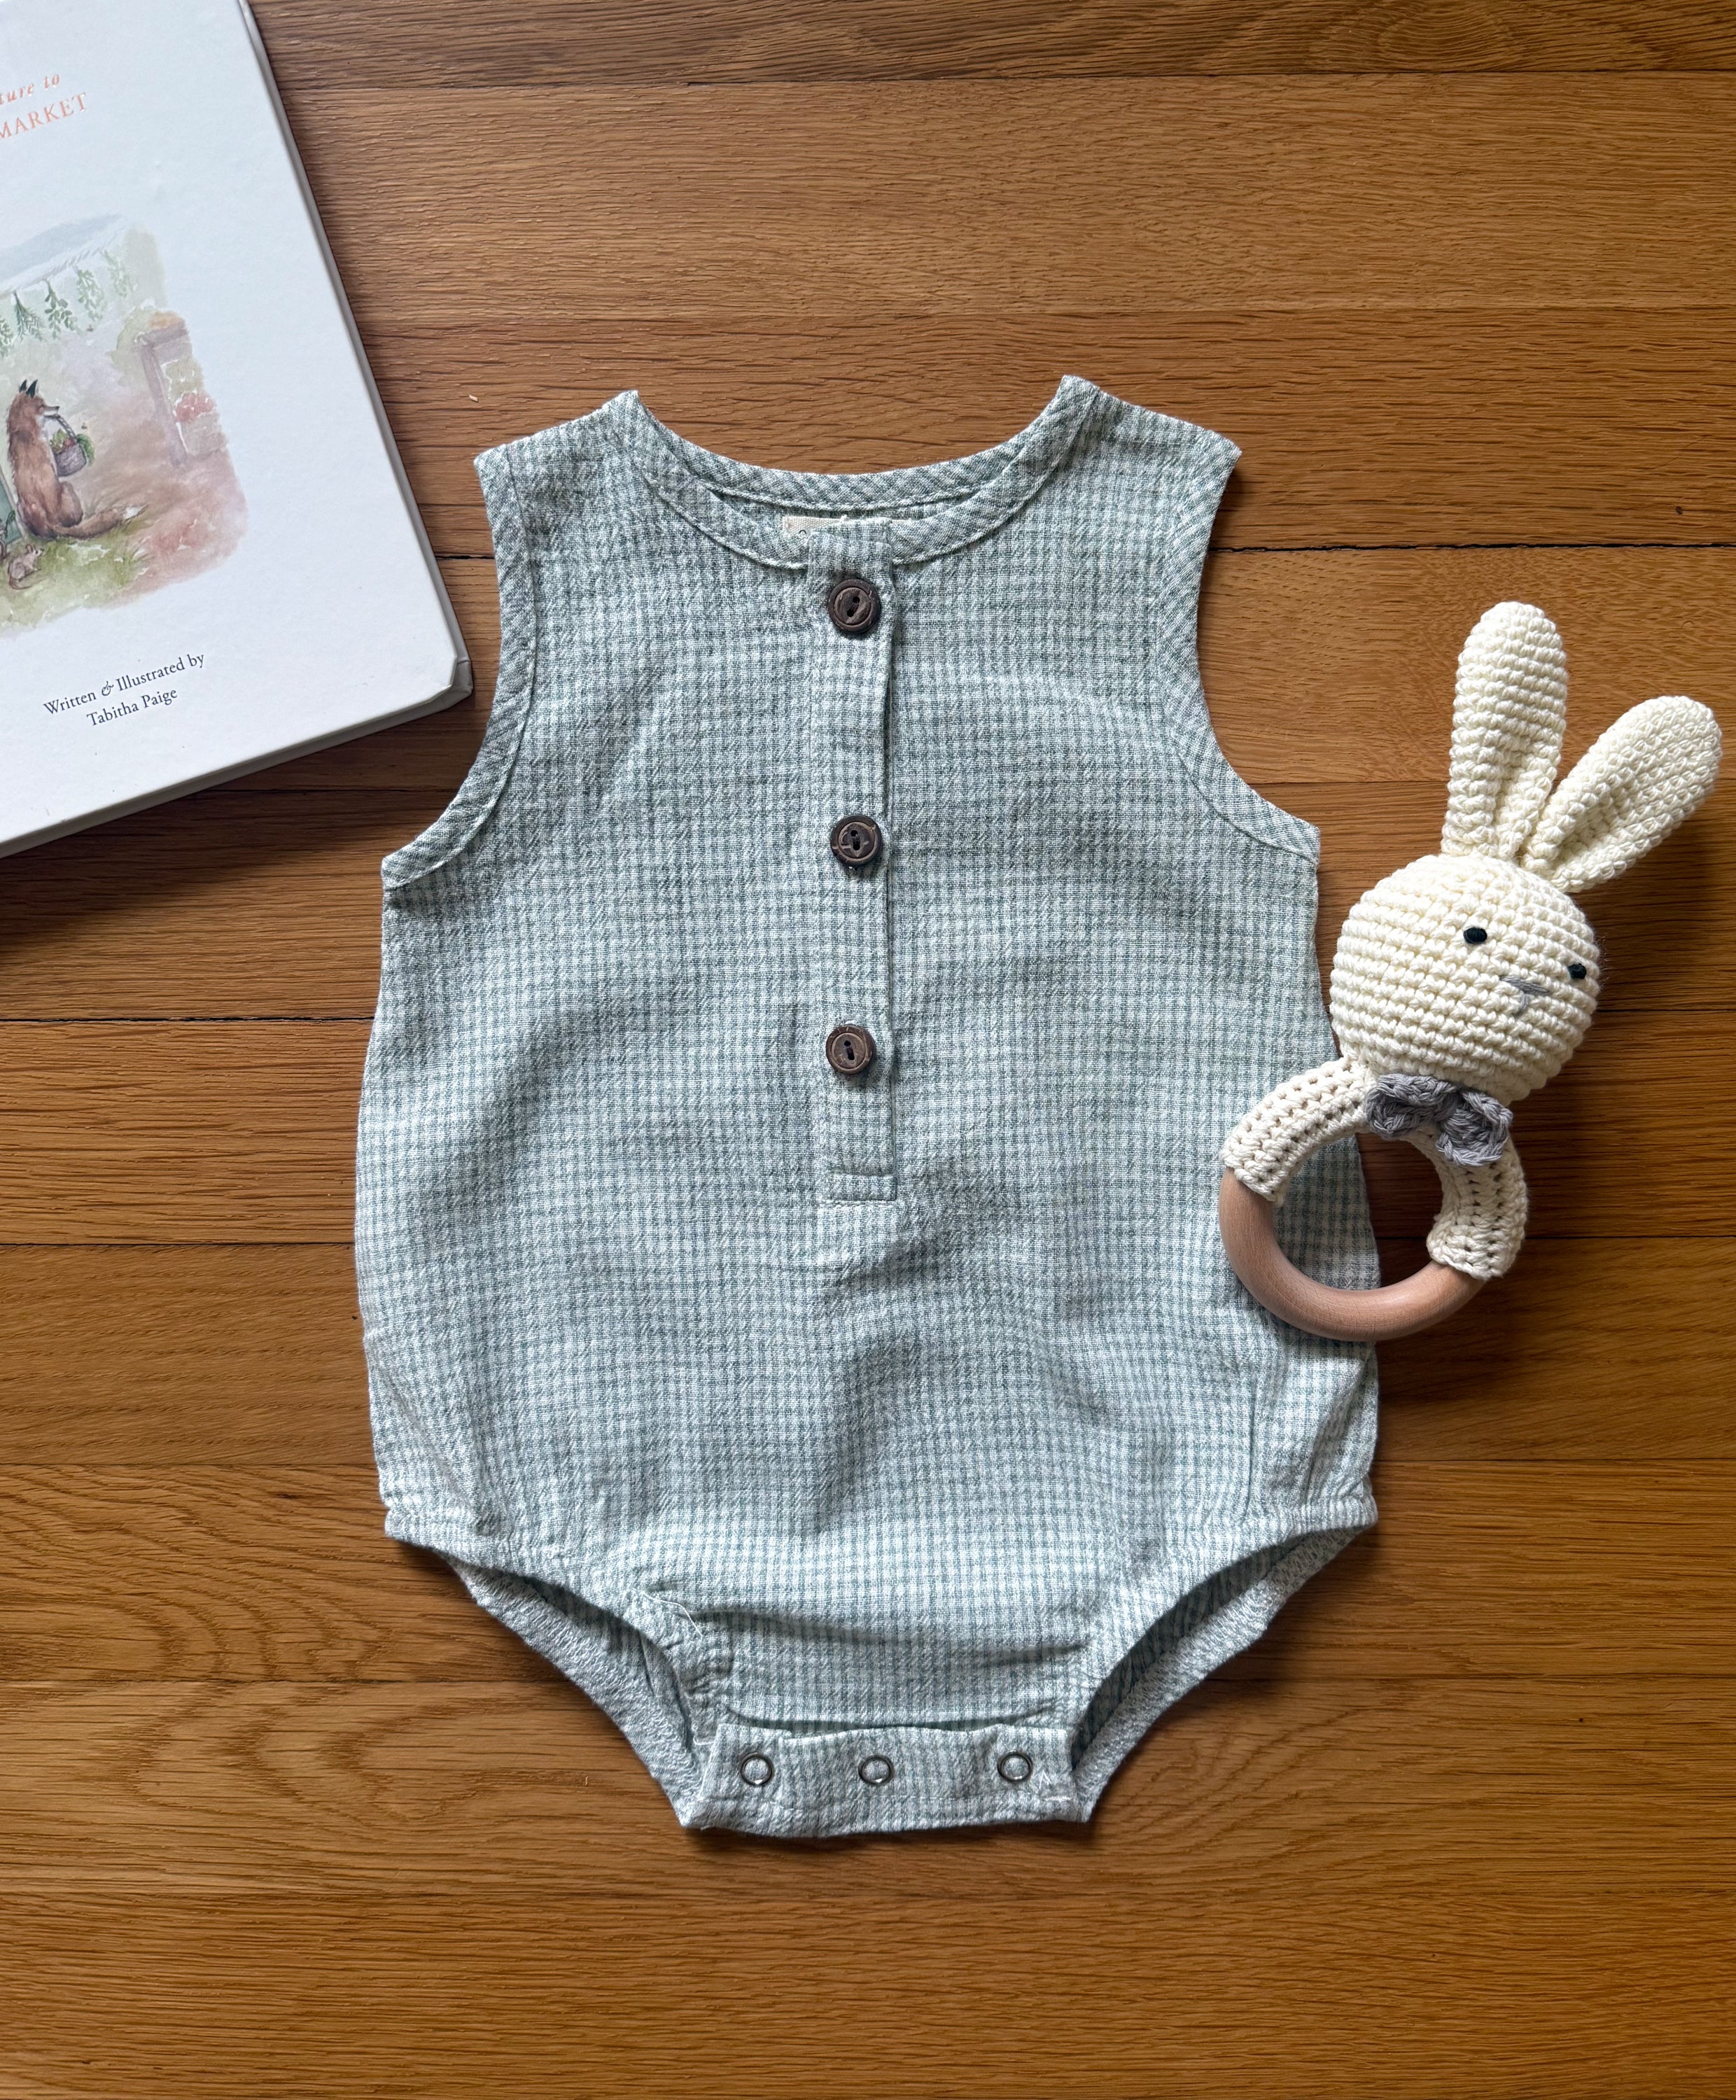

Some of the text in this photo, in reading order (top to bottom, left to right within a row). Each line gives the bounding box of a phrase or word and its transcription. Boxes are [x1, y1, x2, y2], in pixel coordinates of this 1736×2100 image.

[44, 74, 60, 90] to
[43, 654, 205, 715] Written & Illustrated by
[87, 690, 178, 726] Tabitha Paige
